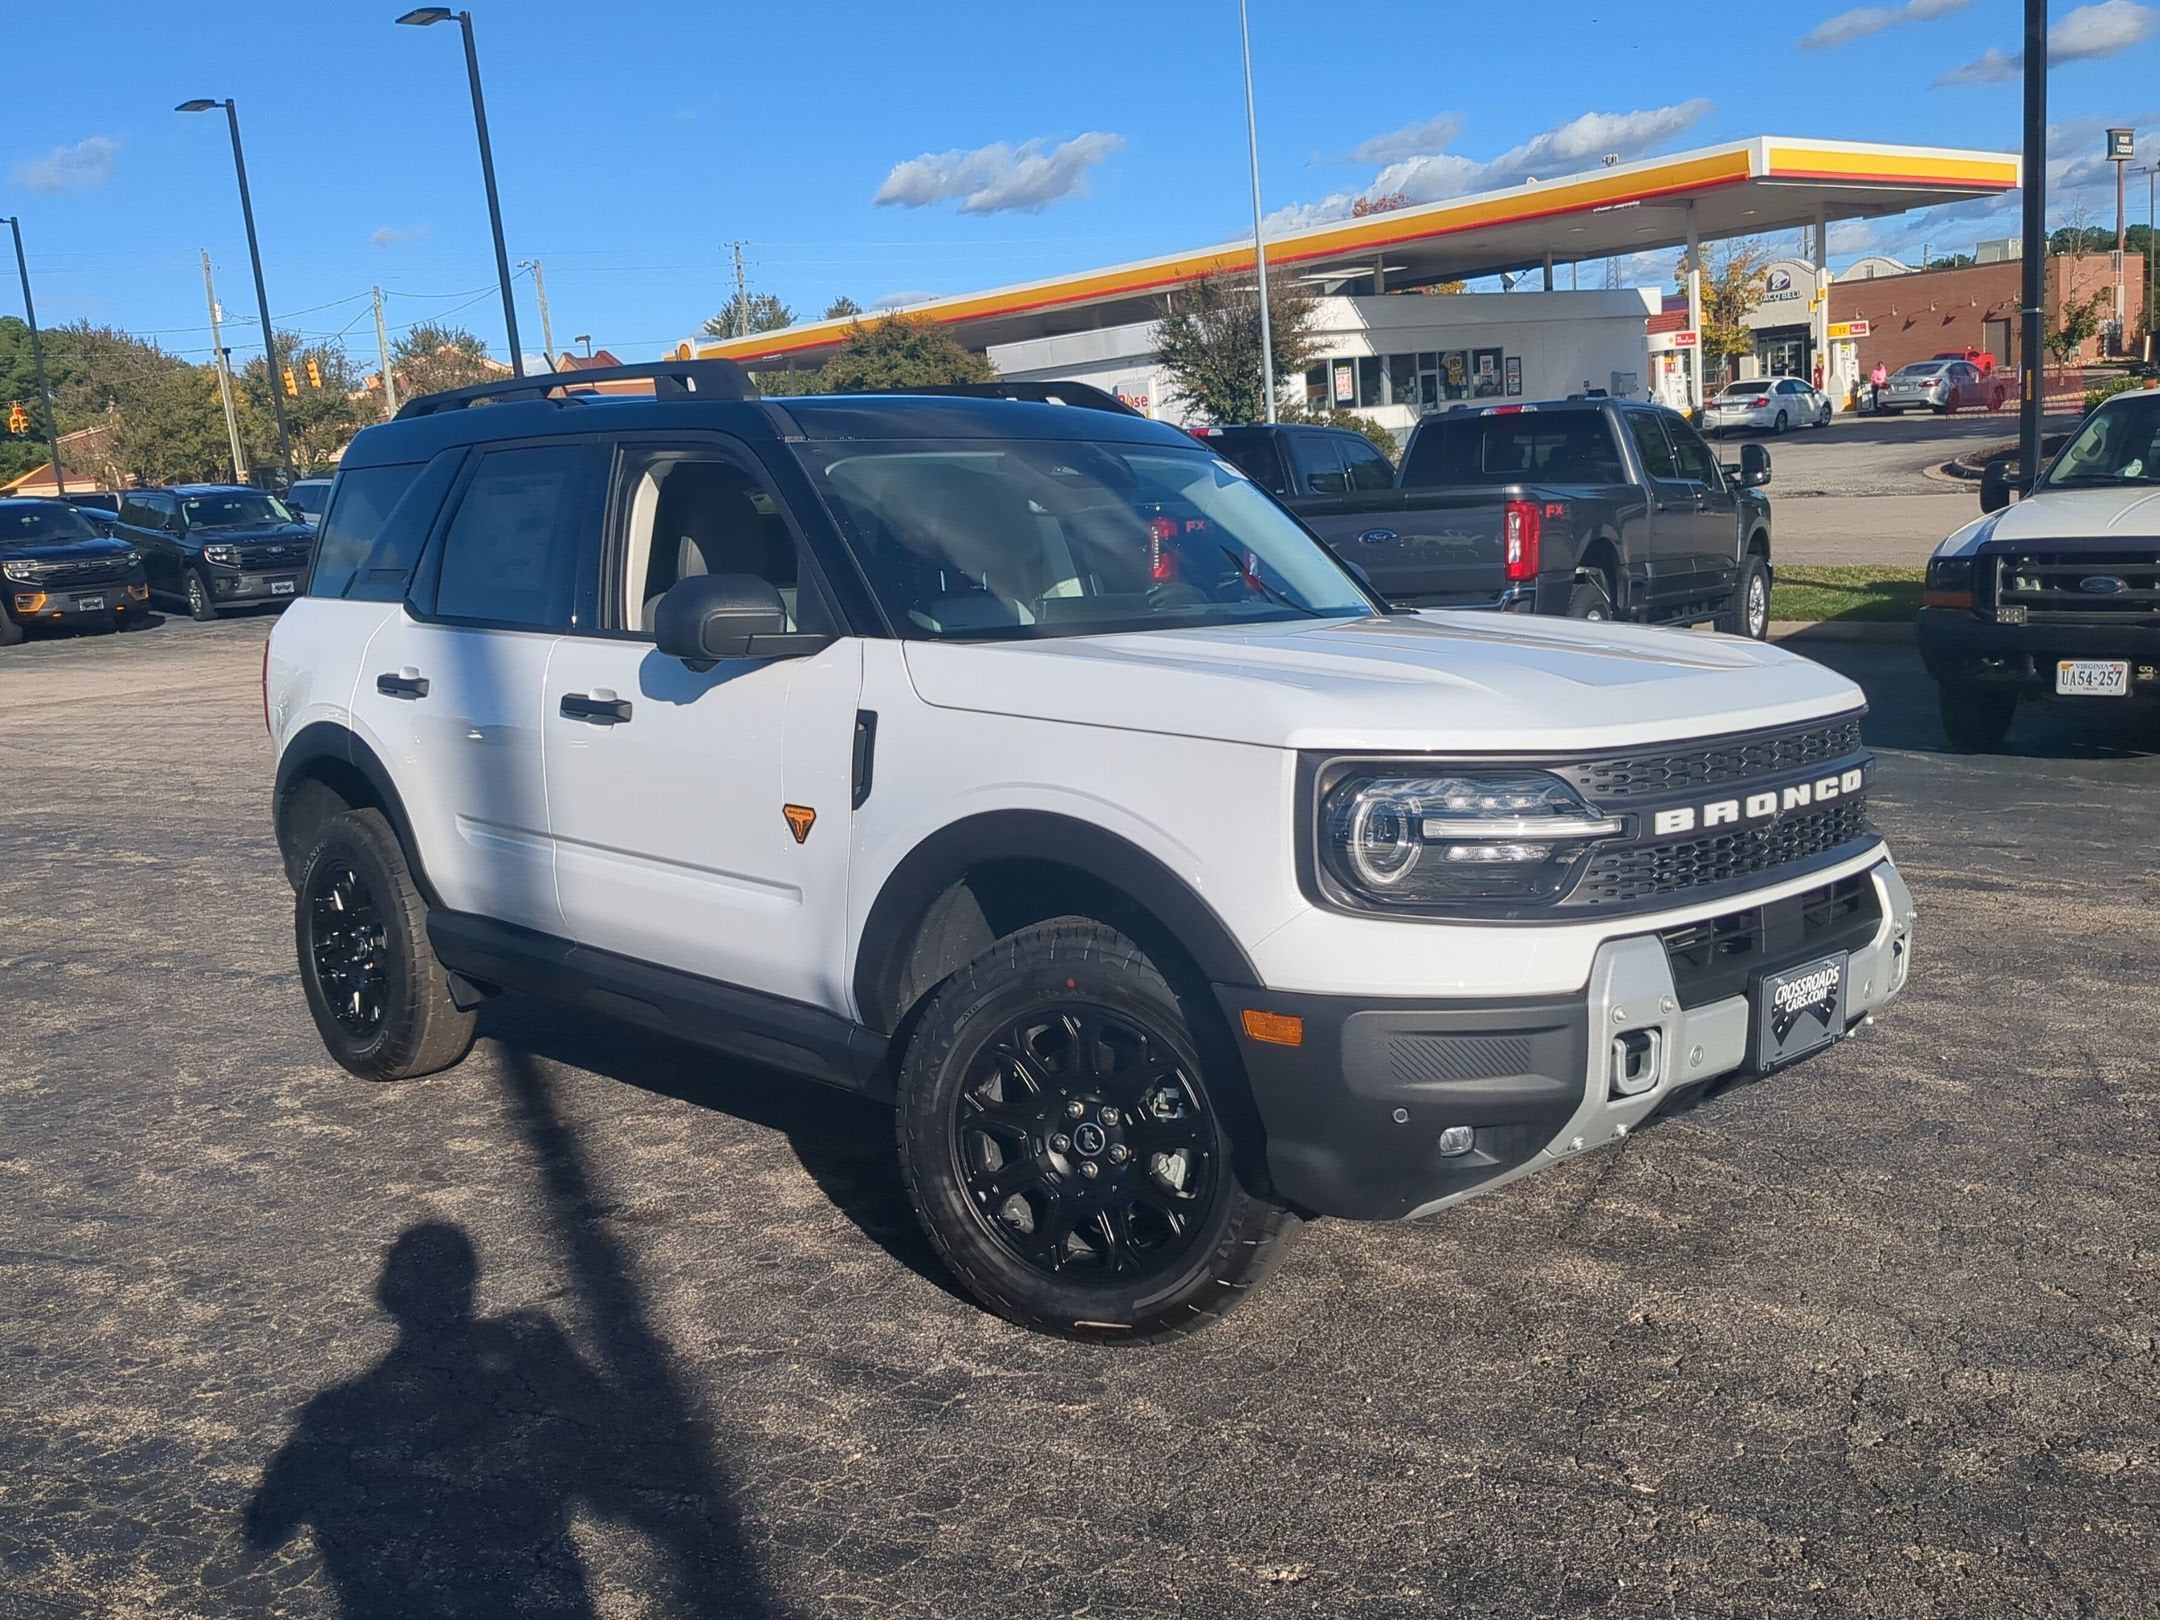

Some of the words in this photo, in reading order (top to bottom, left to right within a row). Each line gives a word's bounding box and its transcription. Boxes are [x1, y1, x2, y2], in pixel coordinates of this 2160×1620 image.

[2061, 670, 2123, 687] UA54-257
[2076, 663, 2109, 671] VIRGINIA
[1654, 768, 1863, 836] BRONCO
[1774, 965, 1841, 1006] CROSSROADS
[1785, 986, 1829, 1013] CARS.COM
